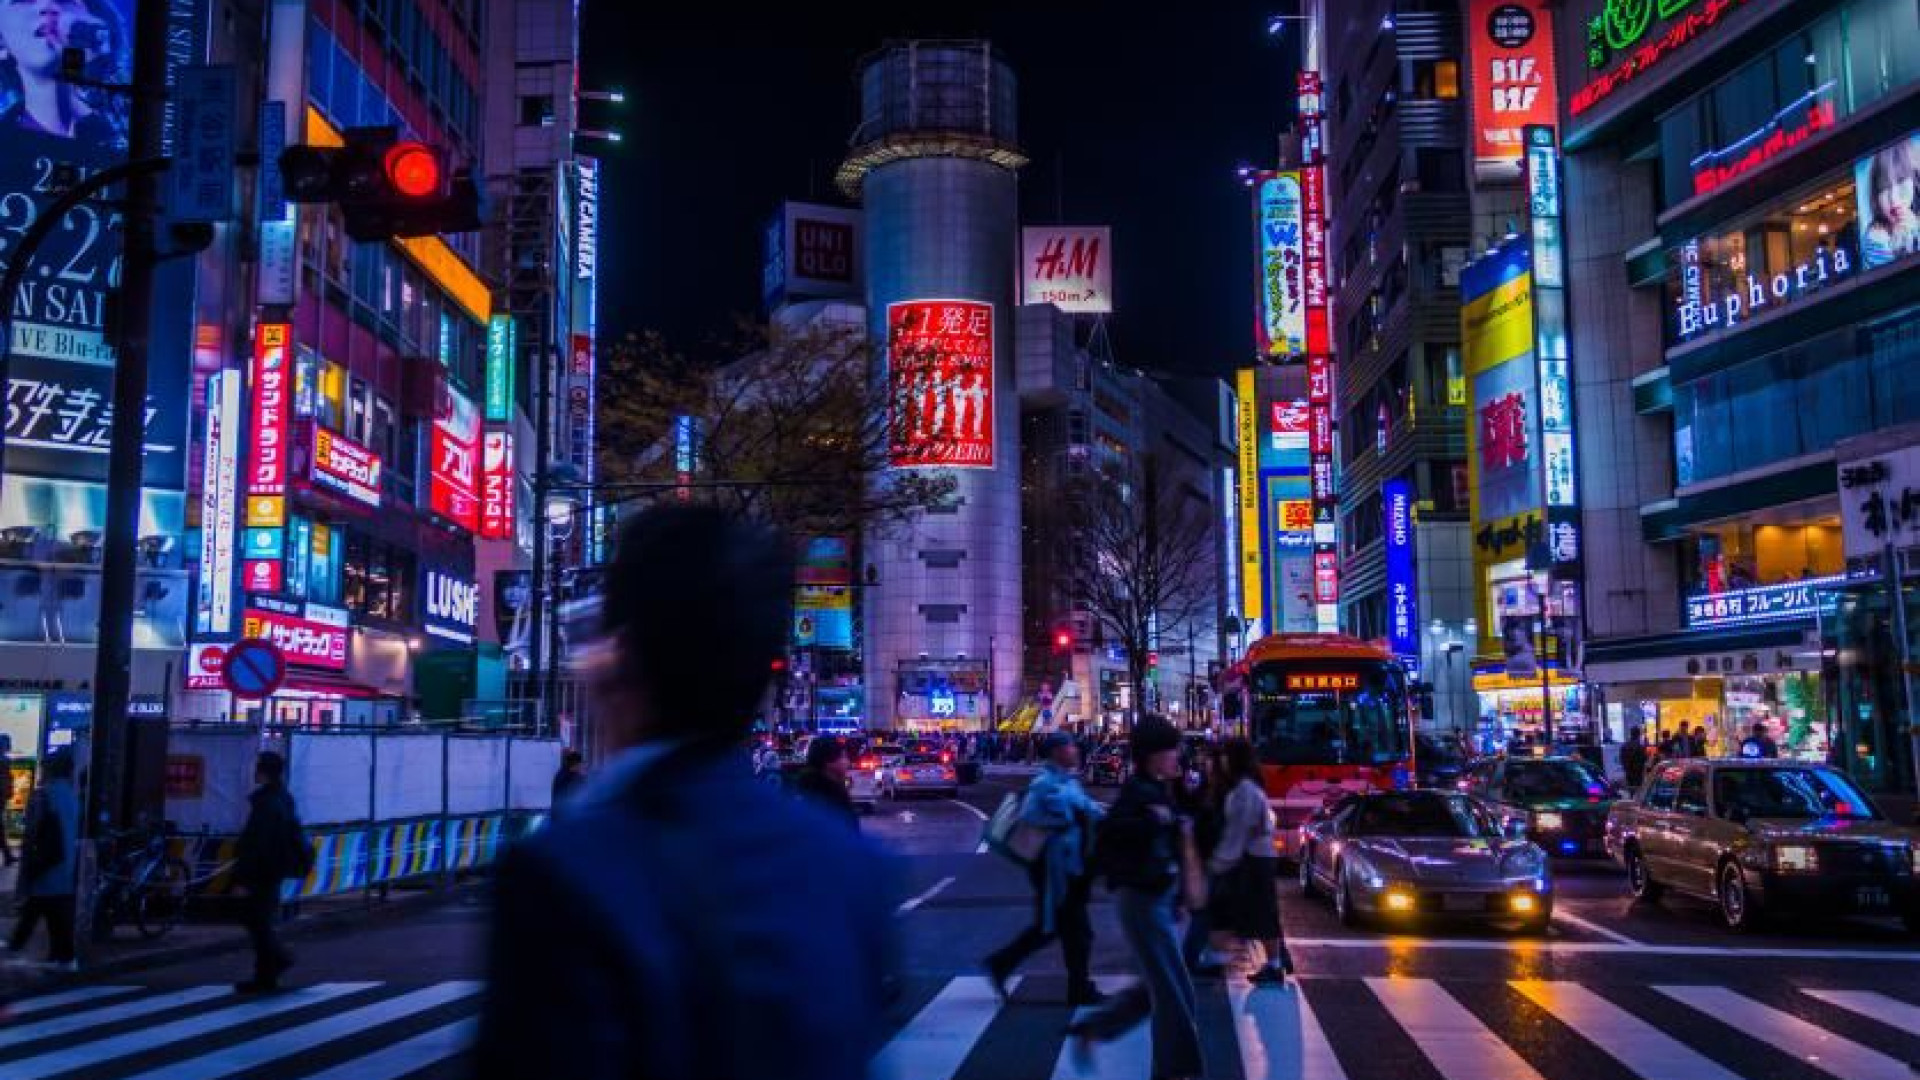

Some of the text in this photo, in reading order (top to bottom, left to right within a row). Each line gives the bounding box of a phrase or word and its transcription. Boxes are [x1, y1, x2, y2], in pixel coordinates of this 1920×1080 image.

[1035, 237, 1099, 280] H&M
[1678, 247, 1849, 336] Euphoria
[1393, 493, 1407, 546] MIZUHO
